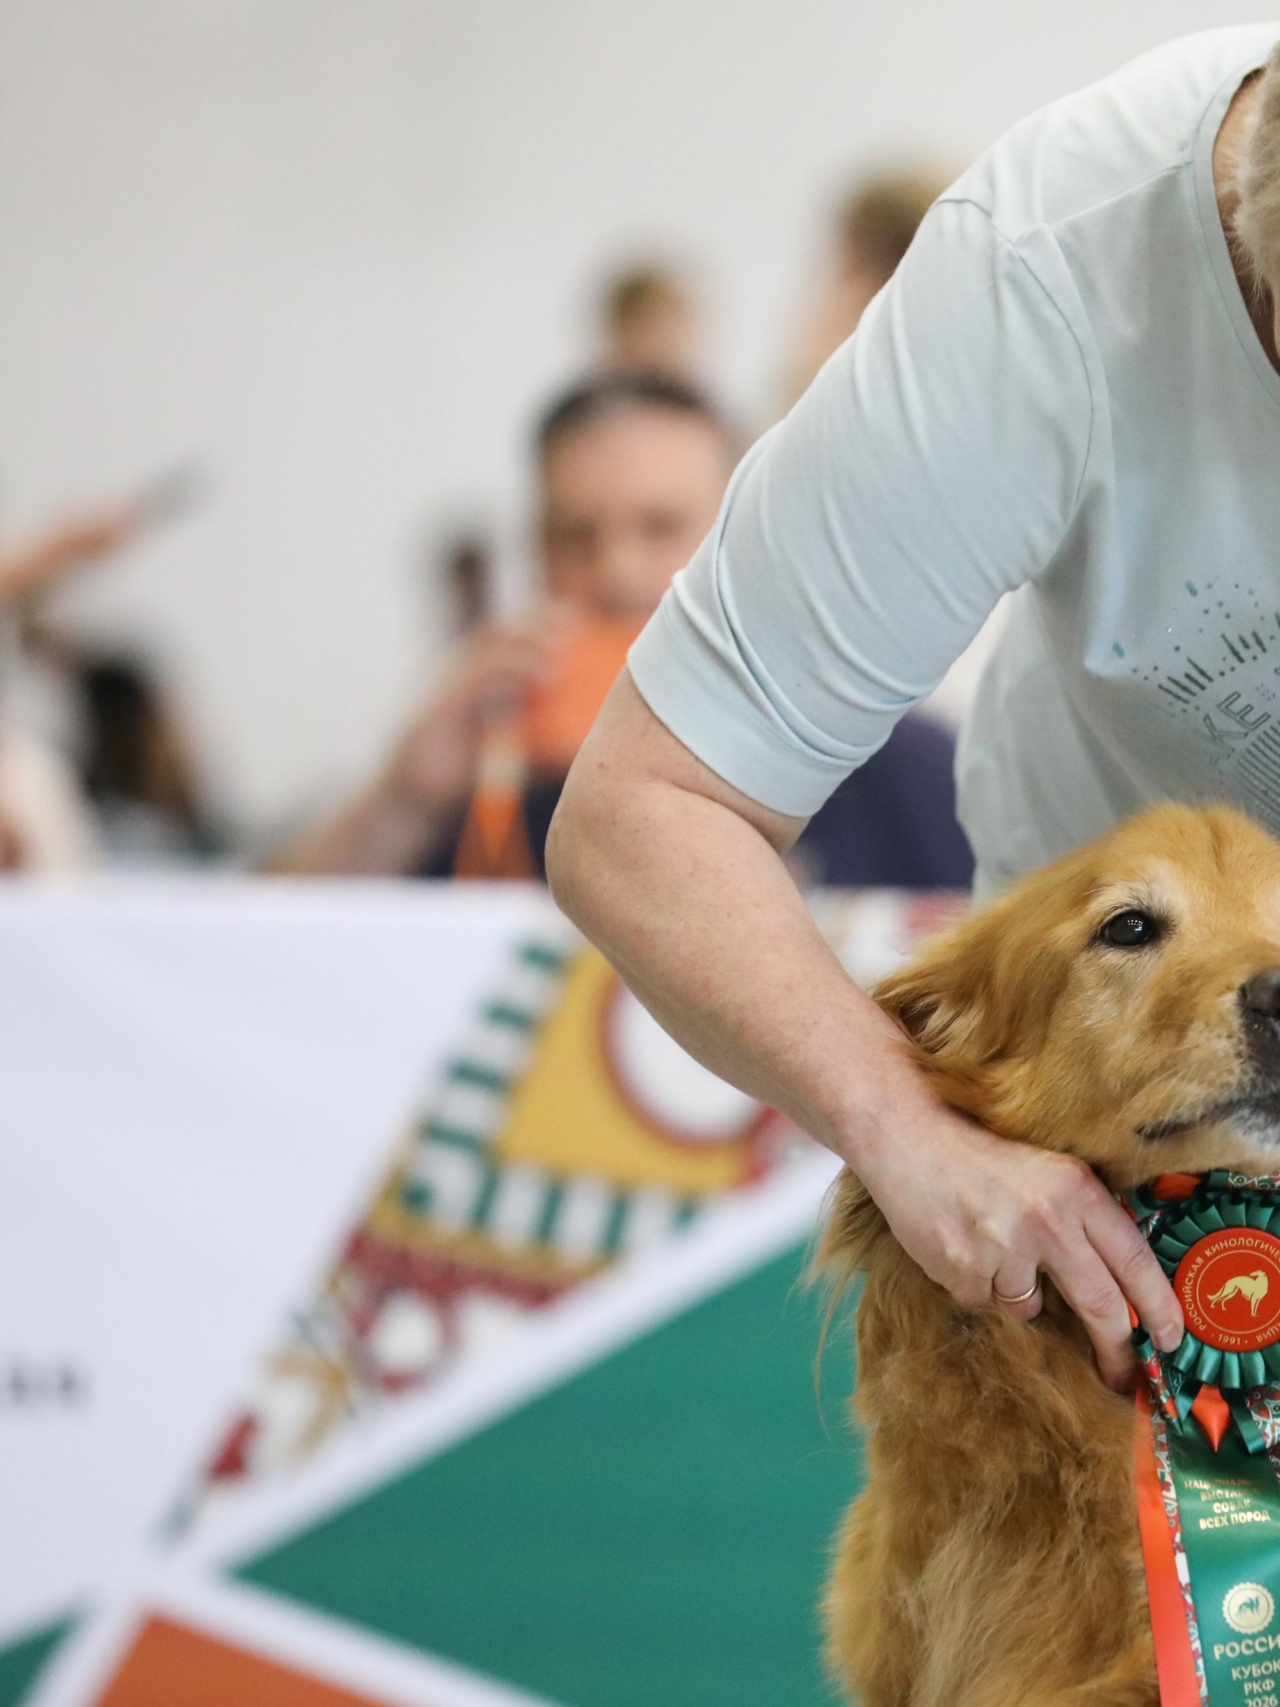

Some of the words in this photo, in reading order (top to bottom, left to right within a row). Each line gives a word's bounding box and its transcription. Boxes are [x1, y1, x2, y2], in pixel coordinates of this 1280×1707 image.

[1182, 1256, 1207, 1331] РОССИЙСКАЯ
[1218, 1333, 1241, 1346] 1991
[1212, 1498, 1251, 1514] СОБАК
[1199, 1515, 1228, 1530] ВСЕХ
[1230, 1509, 1271, 1525] ПОРОД
[1243, 1679, 1275, 1696] РКФ
[1244, 1694, 1279, 1707] 2026
